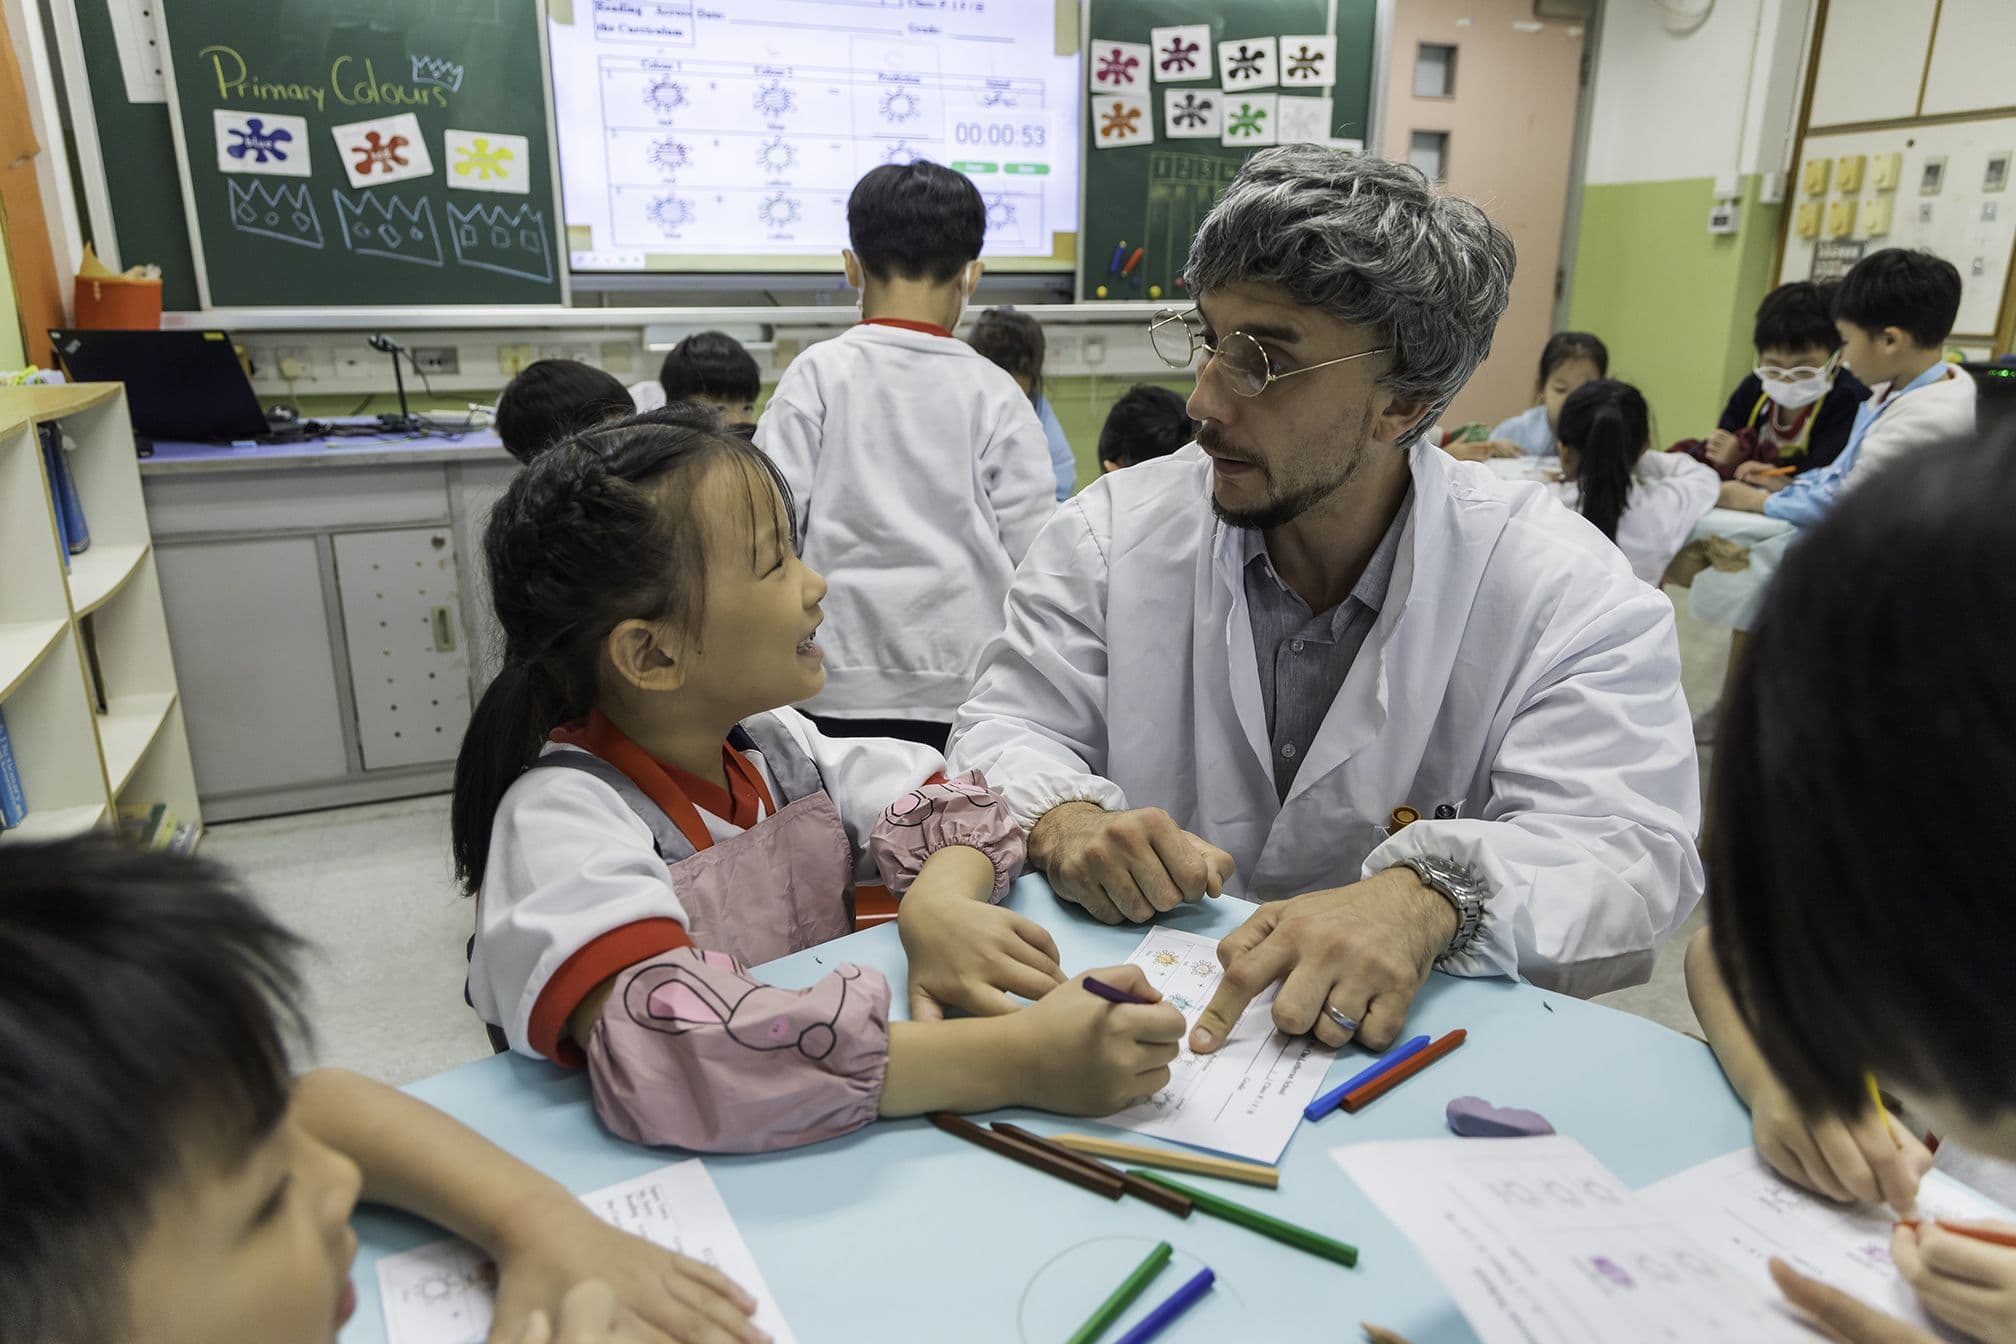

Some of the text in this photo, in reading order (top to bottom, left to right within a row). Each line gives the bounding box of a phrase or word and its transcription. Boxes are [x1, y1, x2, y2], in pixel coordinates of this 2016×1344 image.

[199, 45, 448, 112] Primary Colours
[955, 122, 1047, 147] 00:00:53
